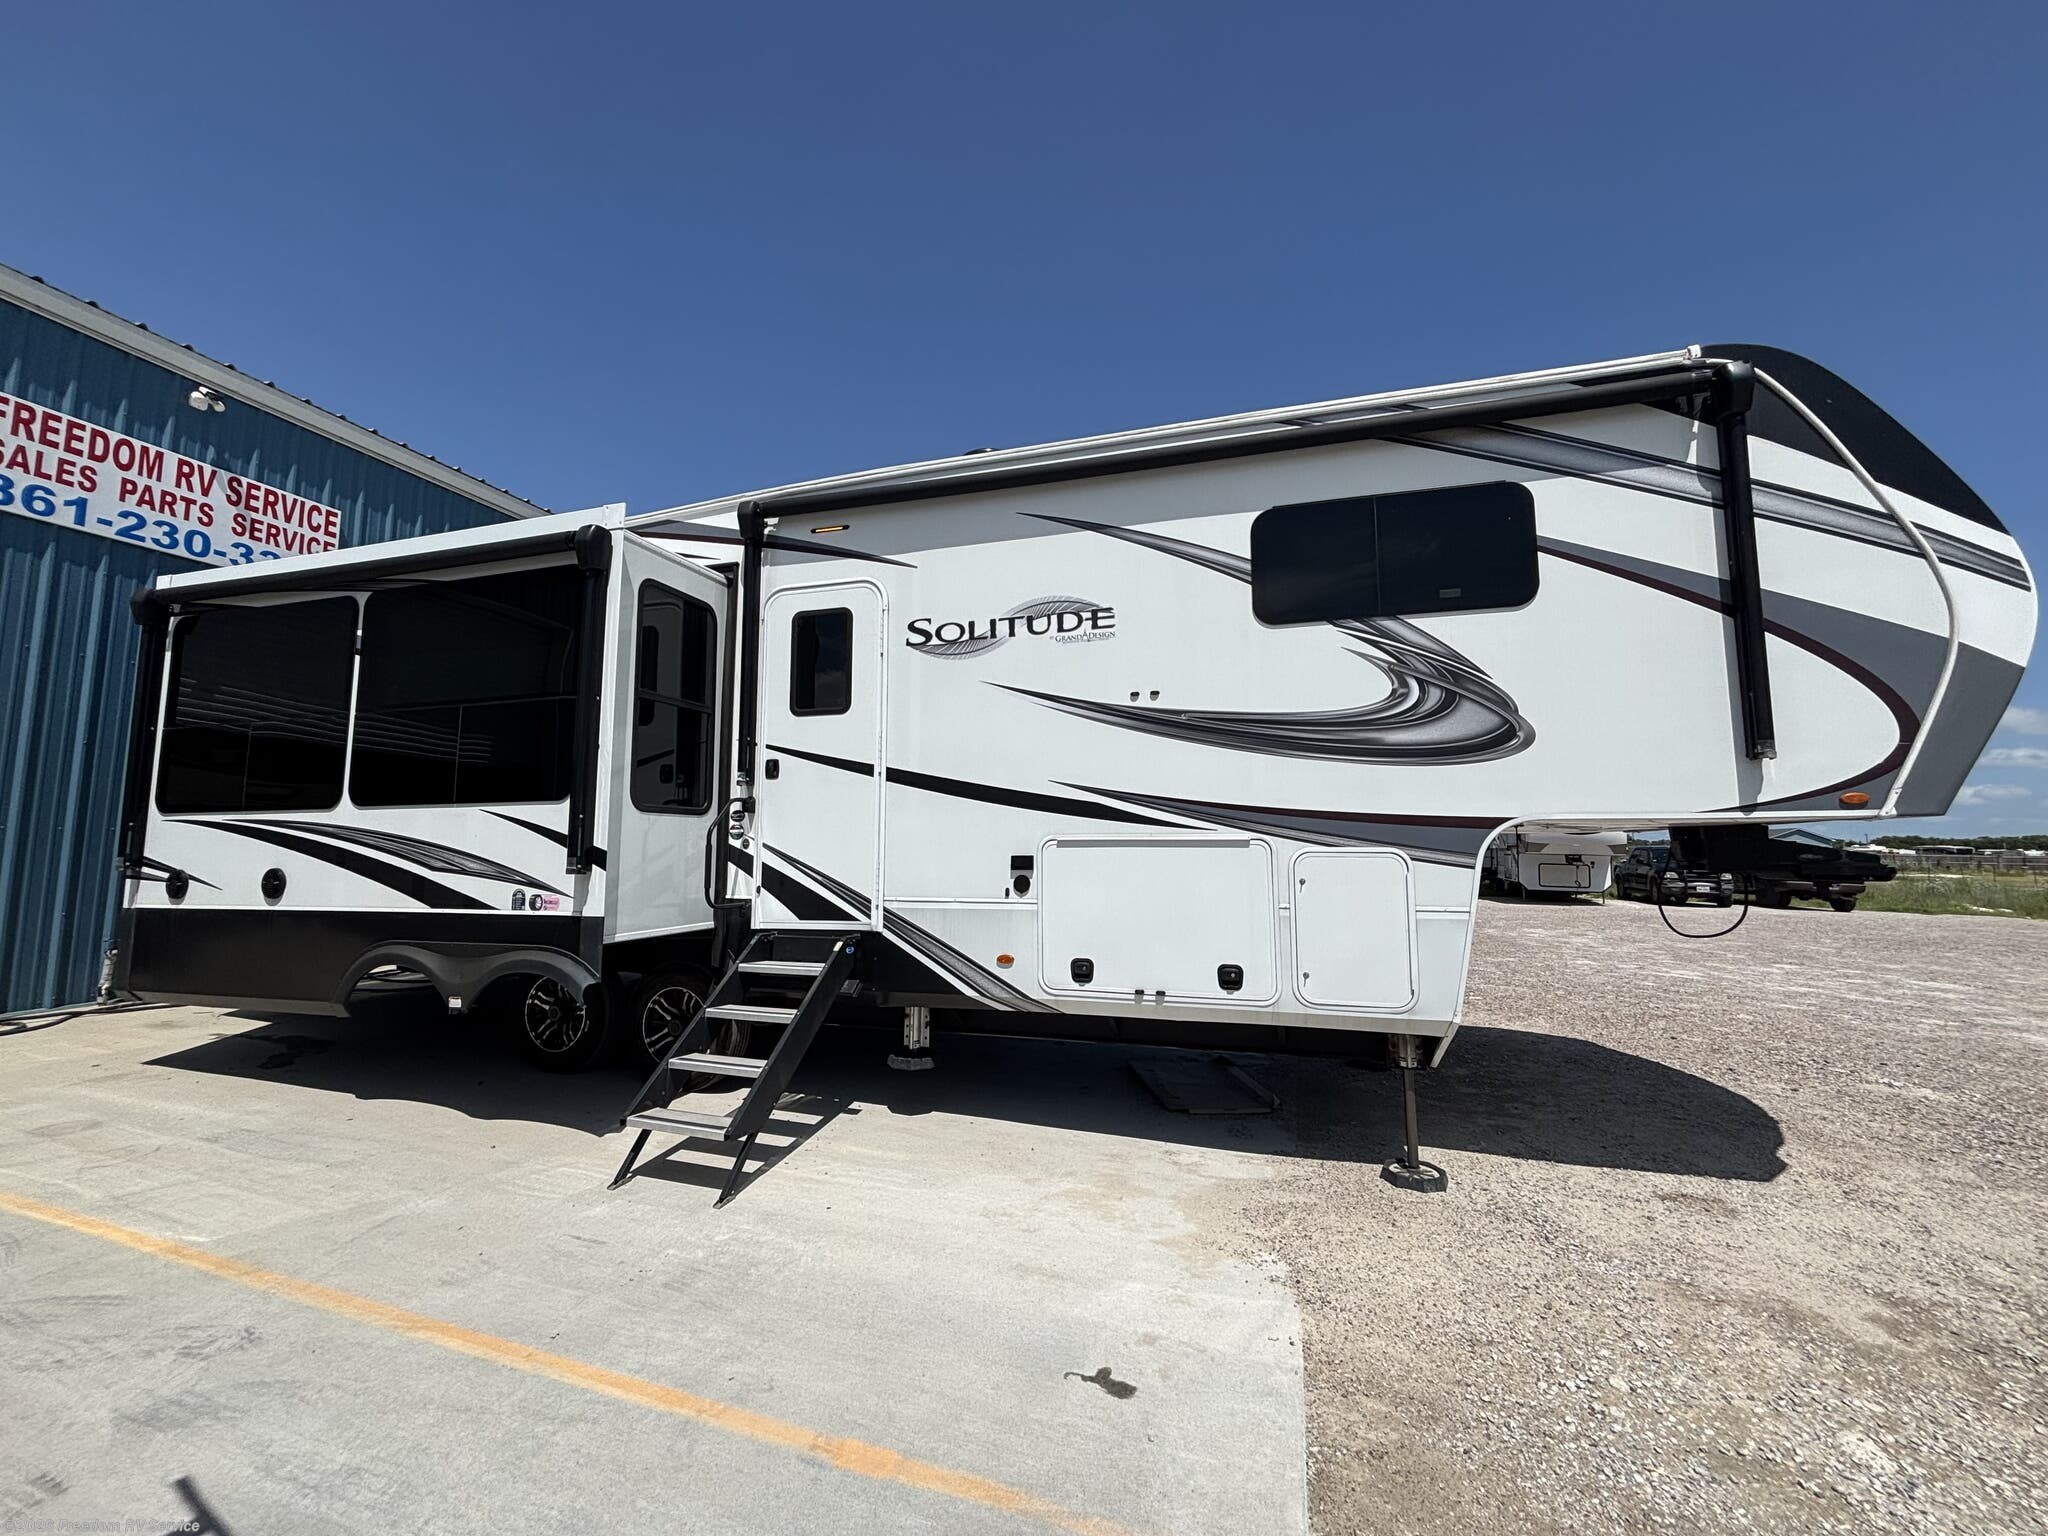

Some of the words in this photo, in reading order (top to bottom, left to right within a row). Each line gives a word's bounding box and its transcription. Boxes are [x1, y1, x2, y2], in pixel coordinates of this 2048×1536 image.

[119, 476, 214, 527] PARTS
[175, 458, 218, 497] RV
[226, 476, 338, 538] SERVICE
